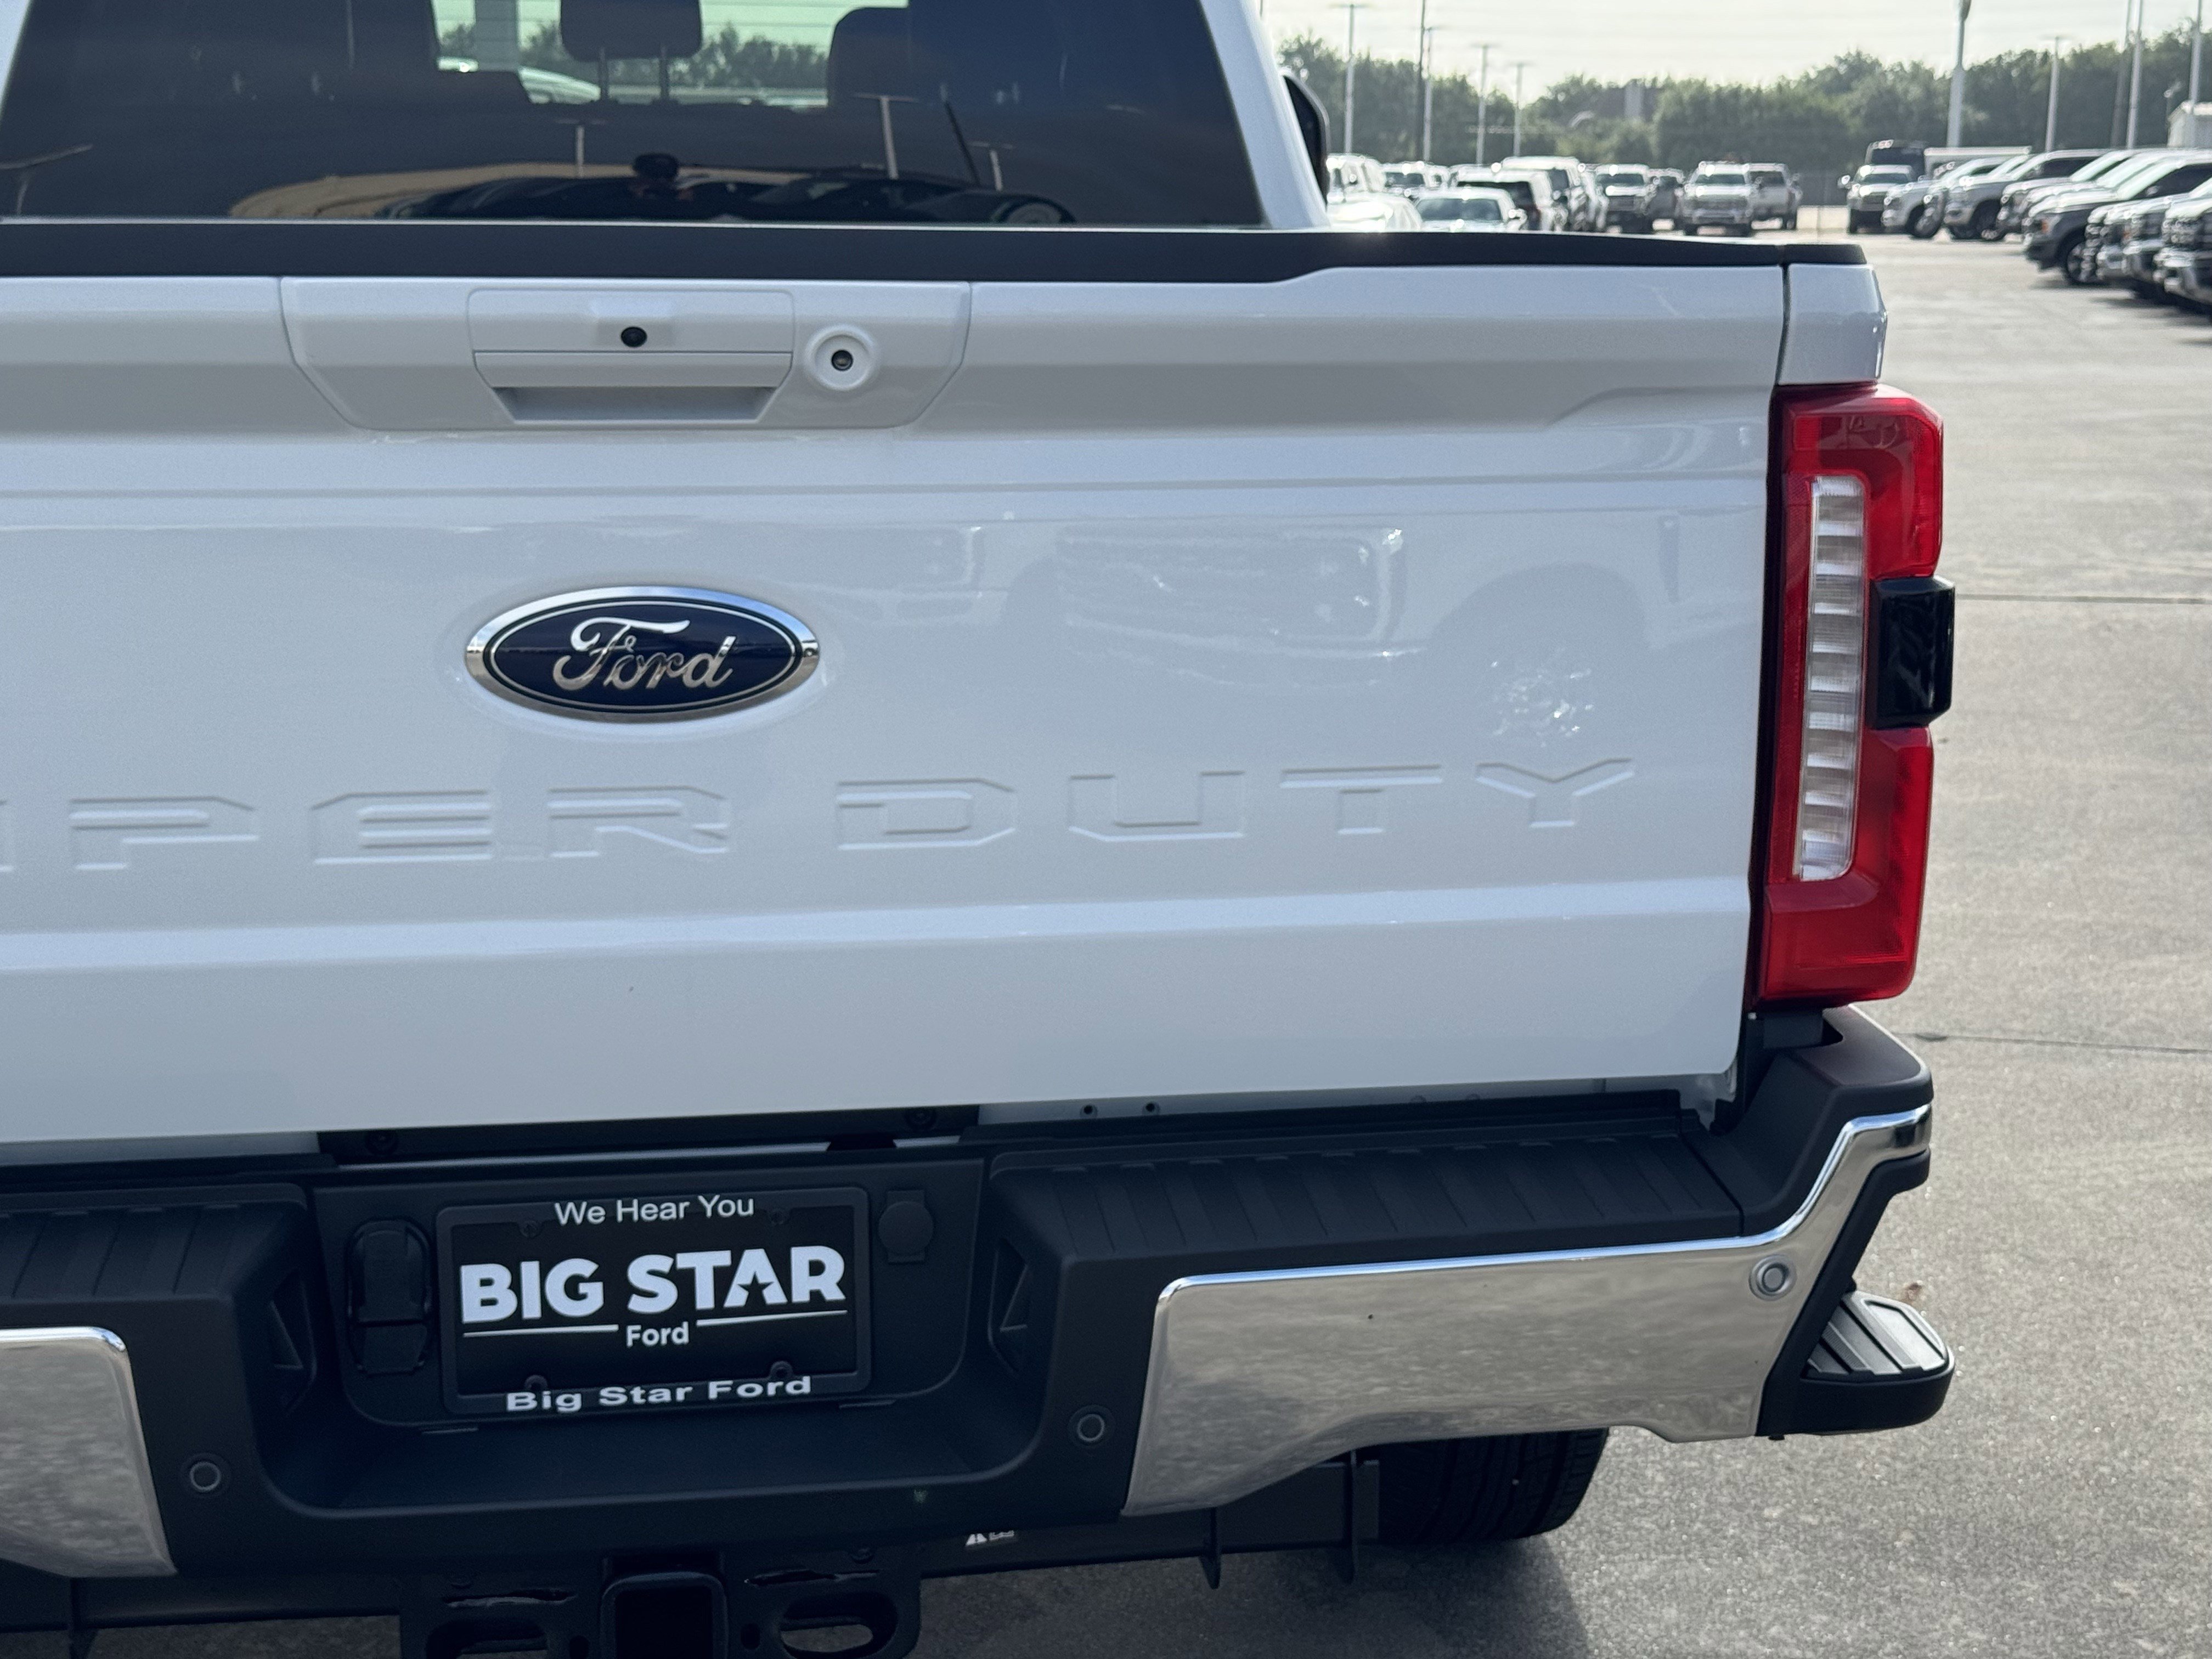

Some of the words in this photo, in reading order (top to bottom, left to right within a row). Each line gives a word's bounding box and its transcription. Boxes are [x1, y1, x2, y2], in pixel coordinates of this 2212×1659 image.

[552, 616, 737, 691] Ford
[0, 785, 730, 873] PER
[835, 757, 1635, 850] DUTY
[554, 1201, 606, 1225] We
[616, 1198, 691, 1222] Hear
[697, 1194, 754, 1217] You
[460, 1257, 605, 1323] BIG
[627, 1245, 846, 1314] STAR
[626, 1321, 690, 1347] Ford
[506, 1390, 582, 1413] Big
[599, 1386, 693, 1406] Star
[708, 1375, 811, 1400] Ford
